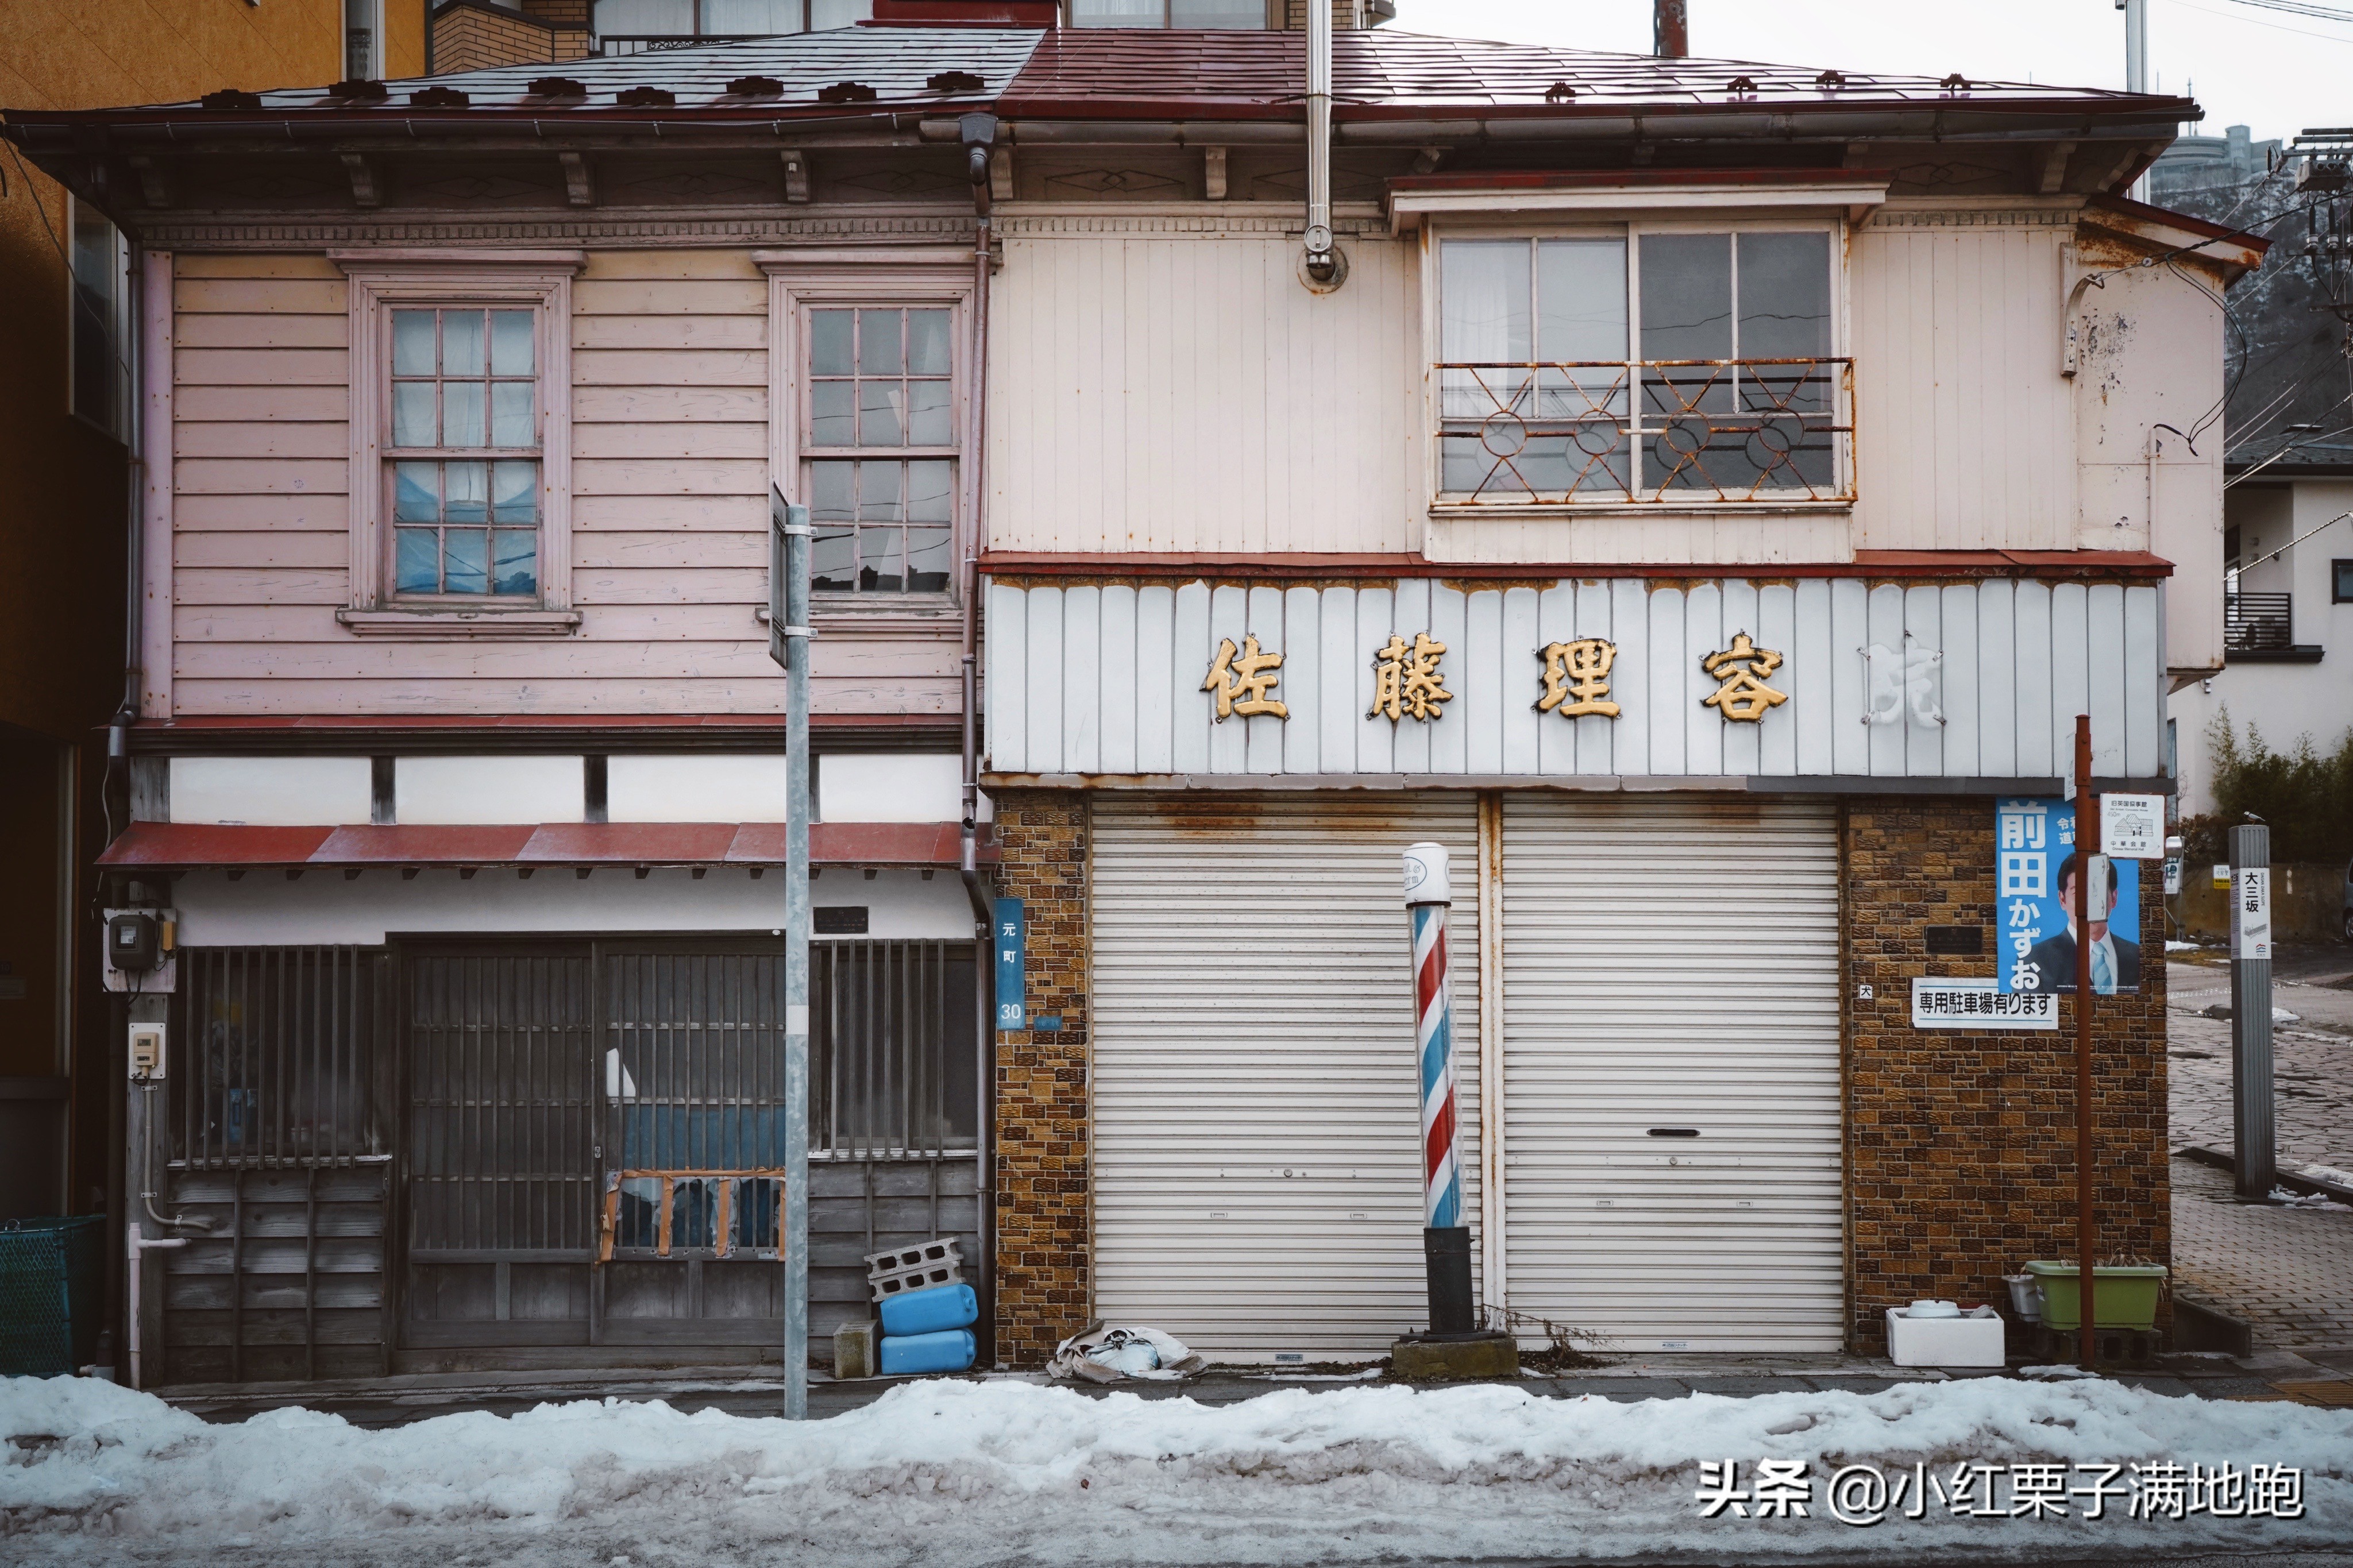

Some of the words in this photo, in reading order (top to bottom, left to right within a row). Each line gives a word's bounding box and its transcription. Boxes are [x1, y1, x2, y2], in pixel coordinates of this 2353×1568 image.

[2059, 832, 2076, 845] 道
[1404, 876, 1419, 885] erm
[1999, 800, 2048, 991] 前田かずお
[2245, 872, 2259, 913] 大三坂
[1002, 922, 1016, 963] 元町
[1861, 986, 1871, 997] 犬
[1001, 1003, 1021, 1020] 30
[1919, 991, 2051, 1015] 専用駐車場有ります
